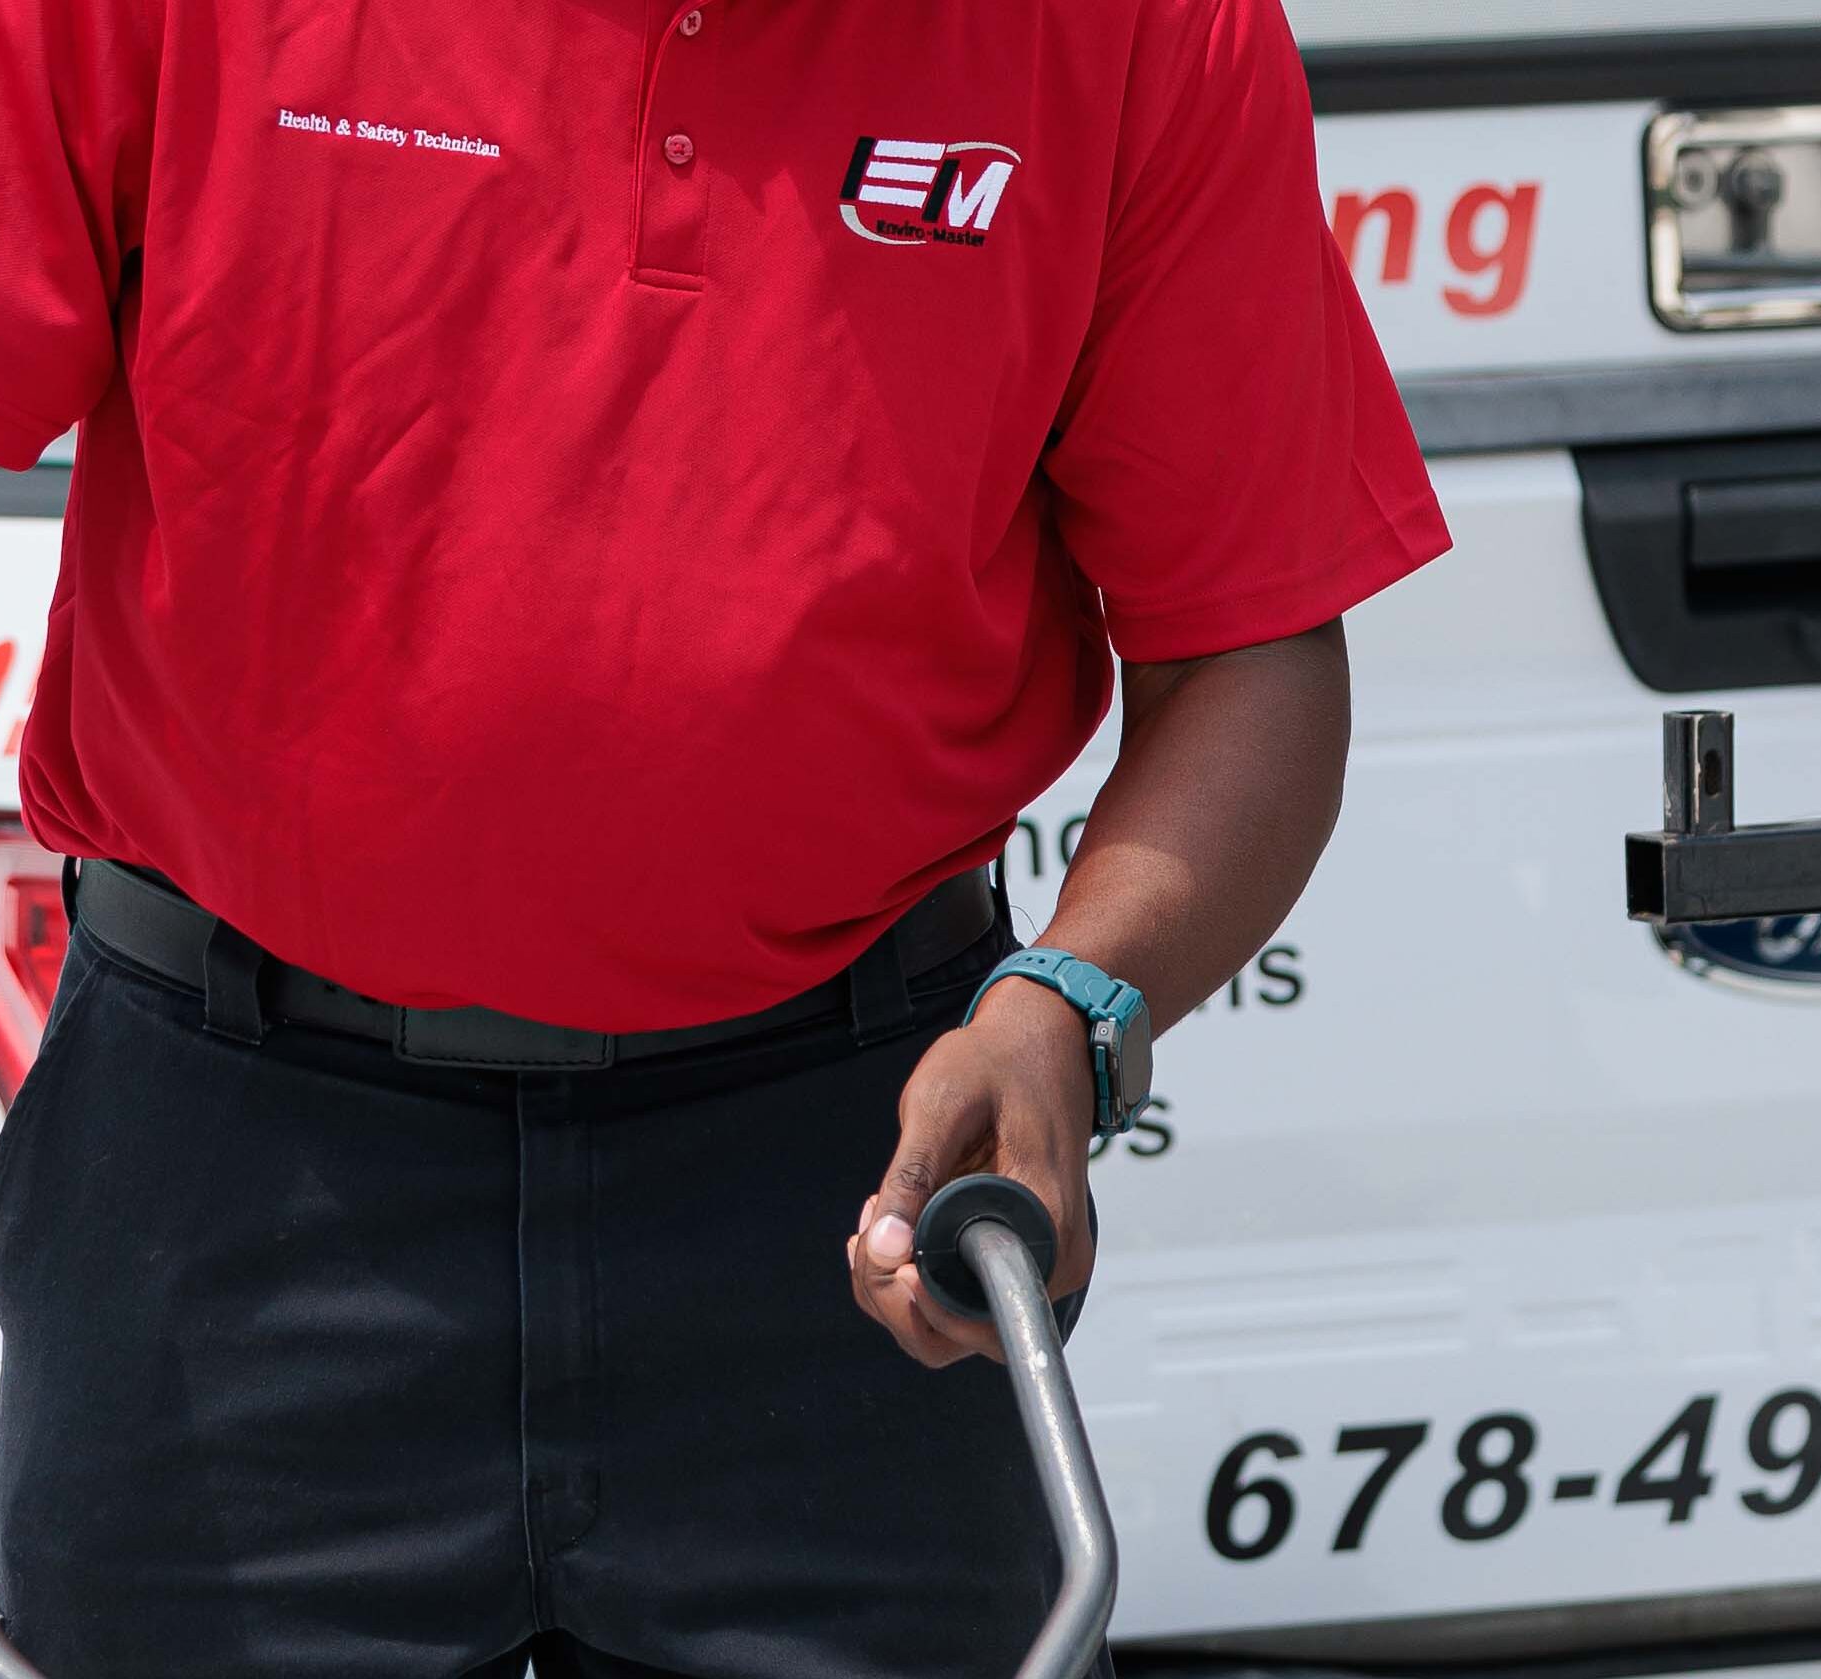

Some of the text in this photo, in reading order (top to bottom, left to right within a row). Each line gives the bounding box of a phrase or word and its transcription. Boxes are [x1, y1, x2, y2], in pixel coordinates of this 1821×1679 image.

[278, 108, 501, 158] Health & Safety Technician
